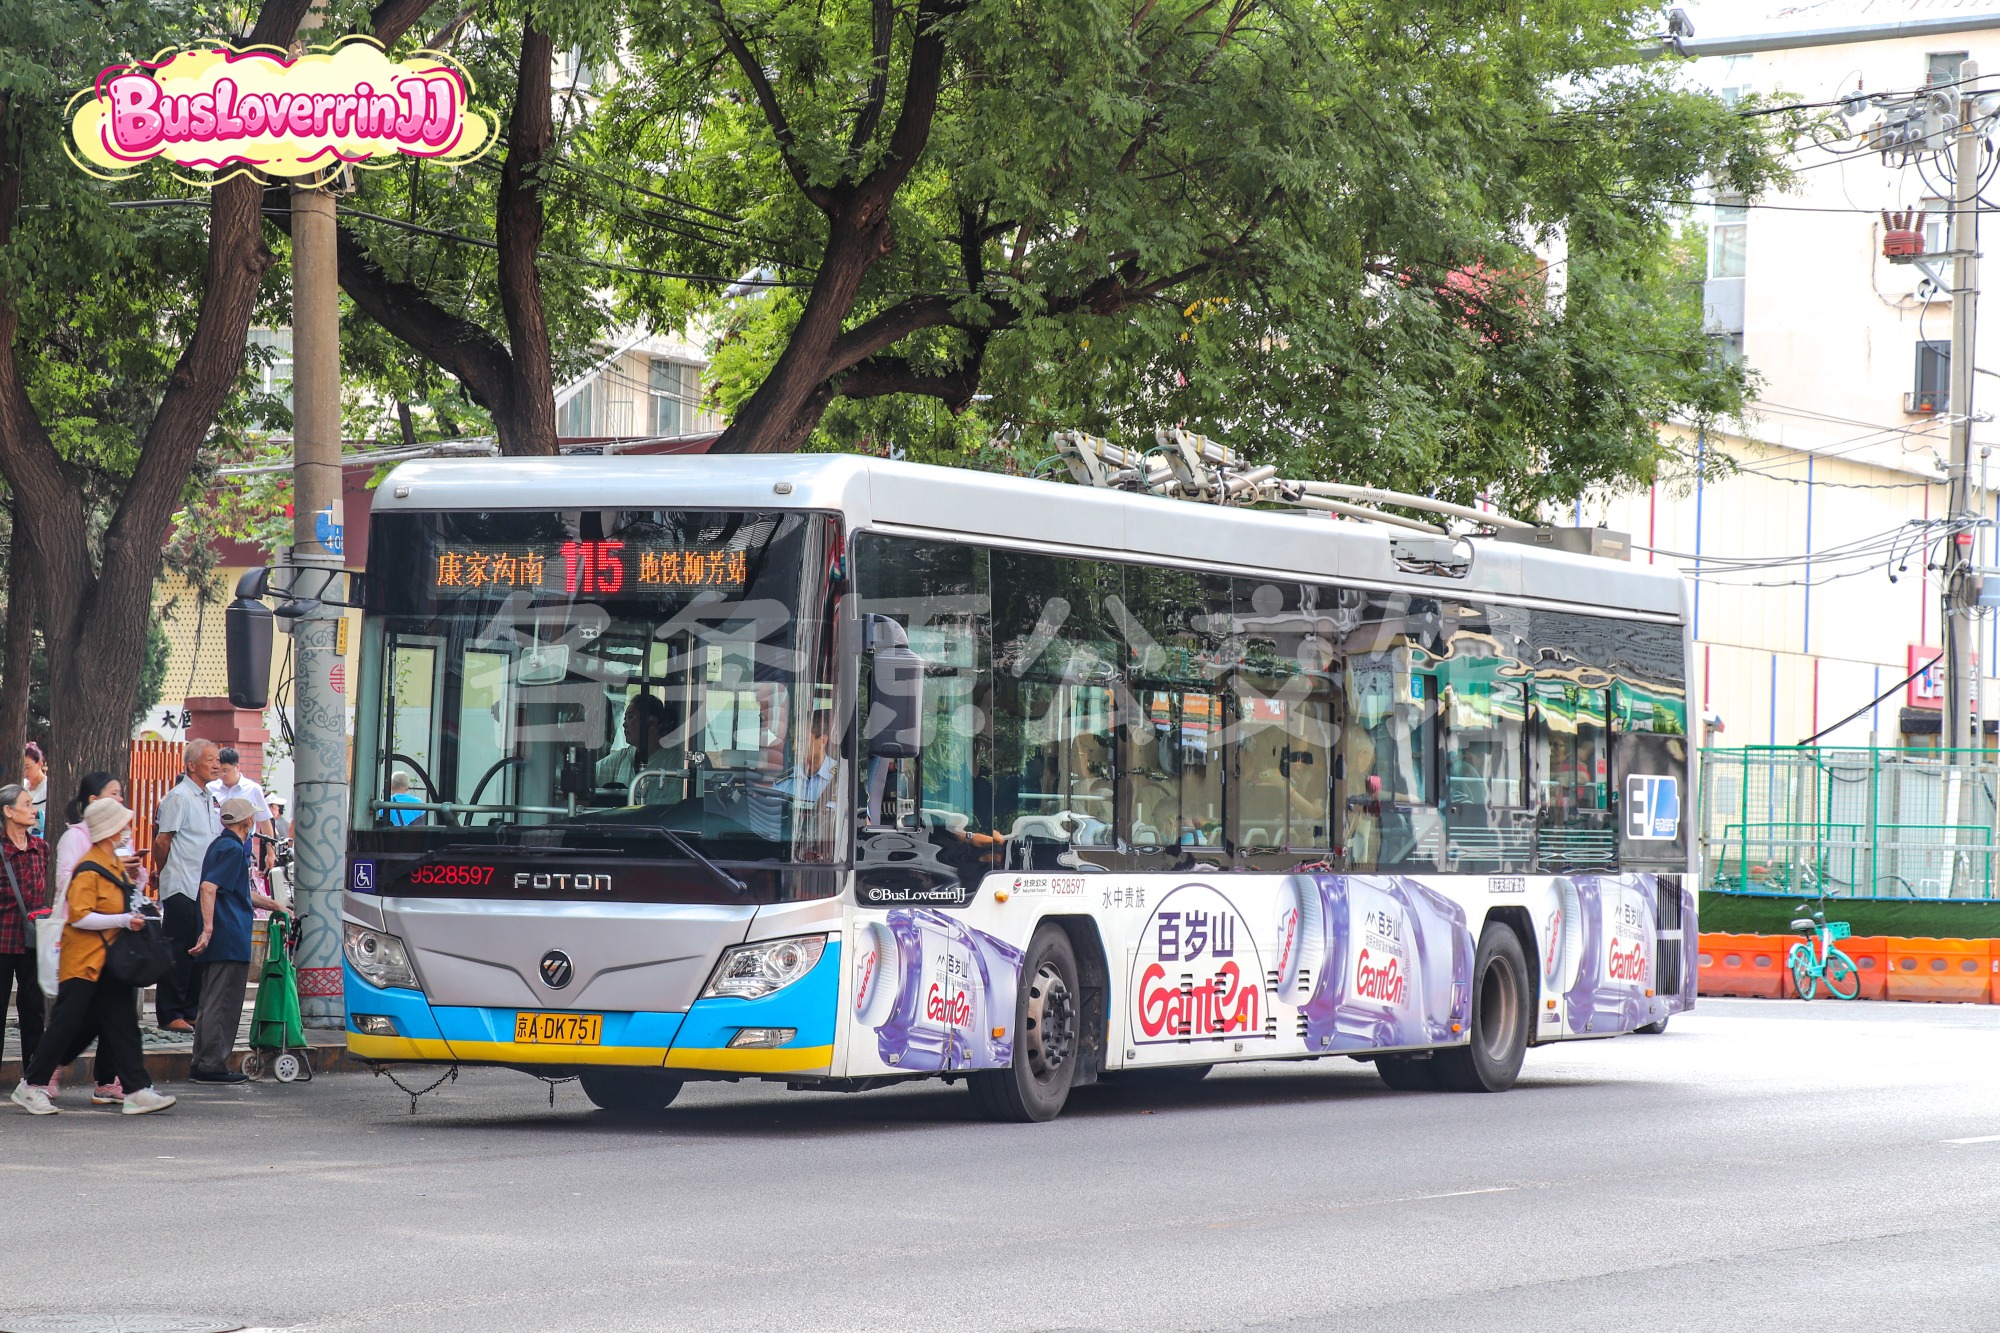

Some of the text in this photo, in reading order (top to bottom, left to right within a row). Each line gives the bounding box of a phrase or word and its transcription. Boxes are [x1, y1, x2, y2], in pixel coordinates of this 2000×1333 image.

[437, 551, 545, 587] 康家沟南
[561, 541, 624, 593] 115
[638, 550, 746, 586] 地铁柳芳站
[411, 865, 494, 885] 9528597
[513, 872, 612, 891] FOTON
[1023, 878, 1047, 888] 北京公交
[1051, 878, 1086, 895] 9528597
[1102, 886, 1146, 909] 水中贵族
[1379, 911, 1401, 942] 百岁山
[1625, 904, 1643, 929] 百岁山
[1158, 910, 1234, 962] 百岁山
[1357, 948, 1403, 1004] Ganten
[1138, 961, 1259, 1037] Ganten
[517, 1017, 597, 1041] 京A·DK751
